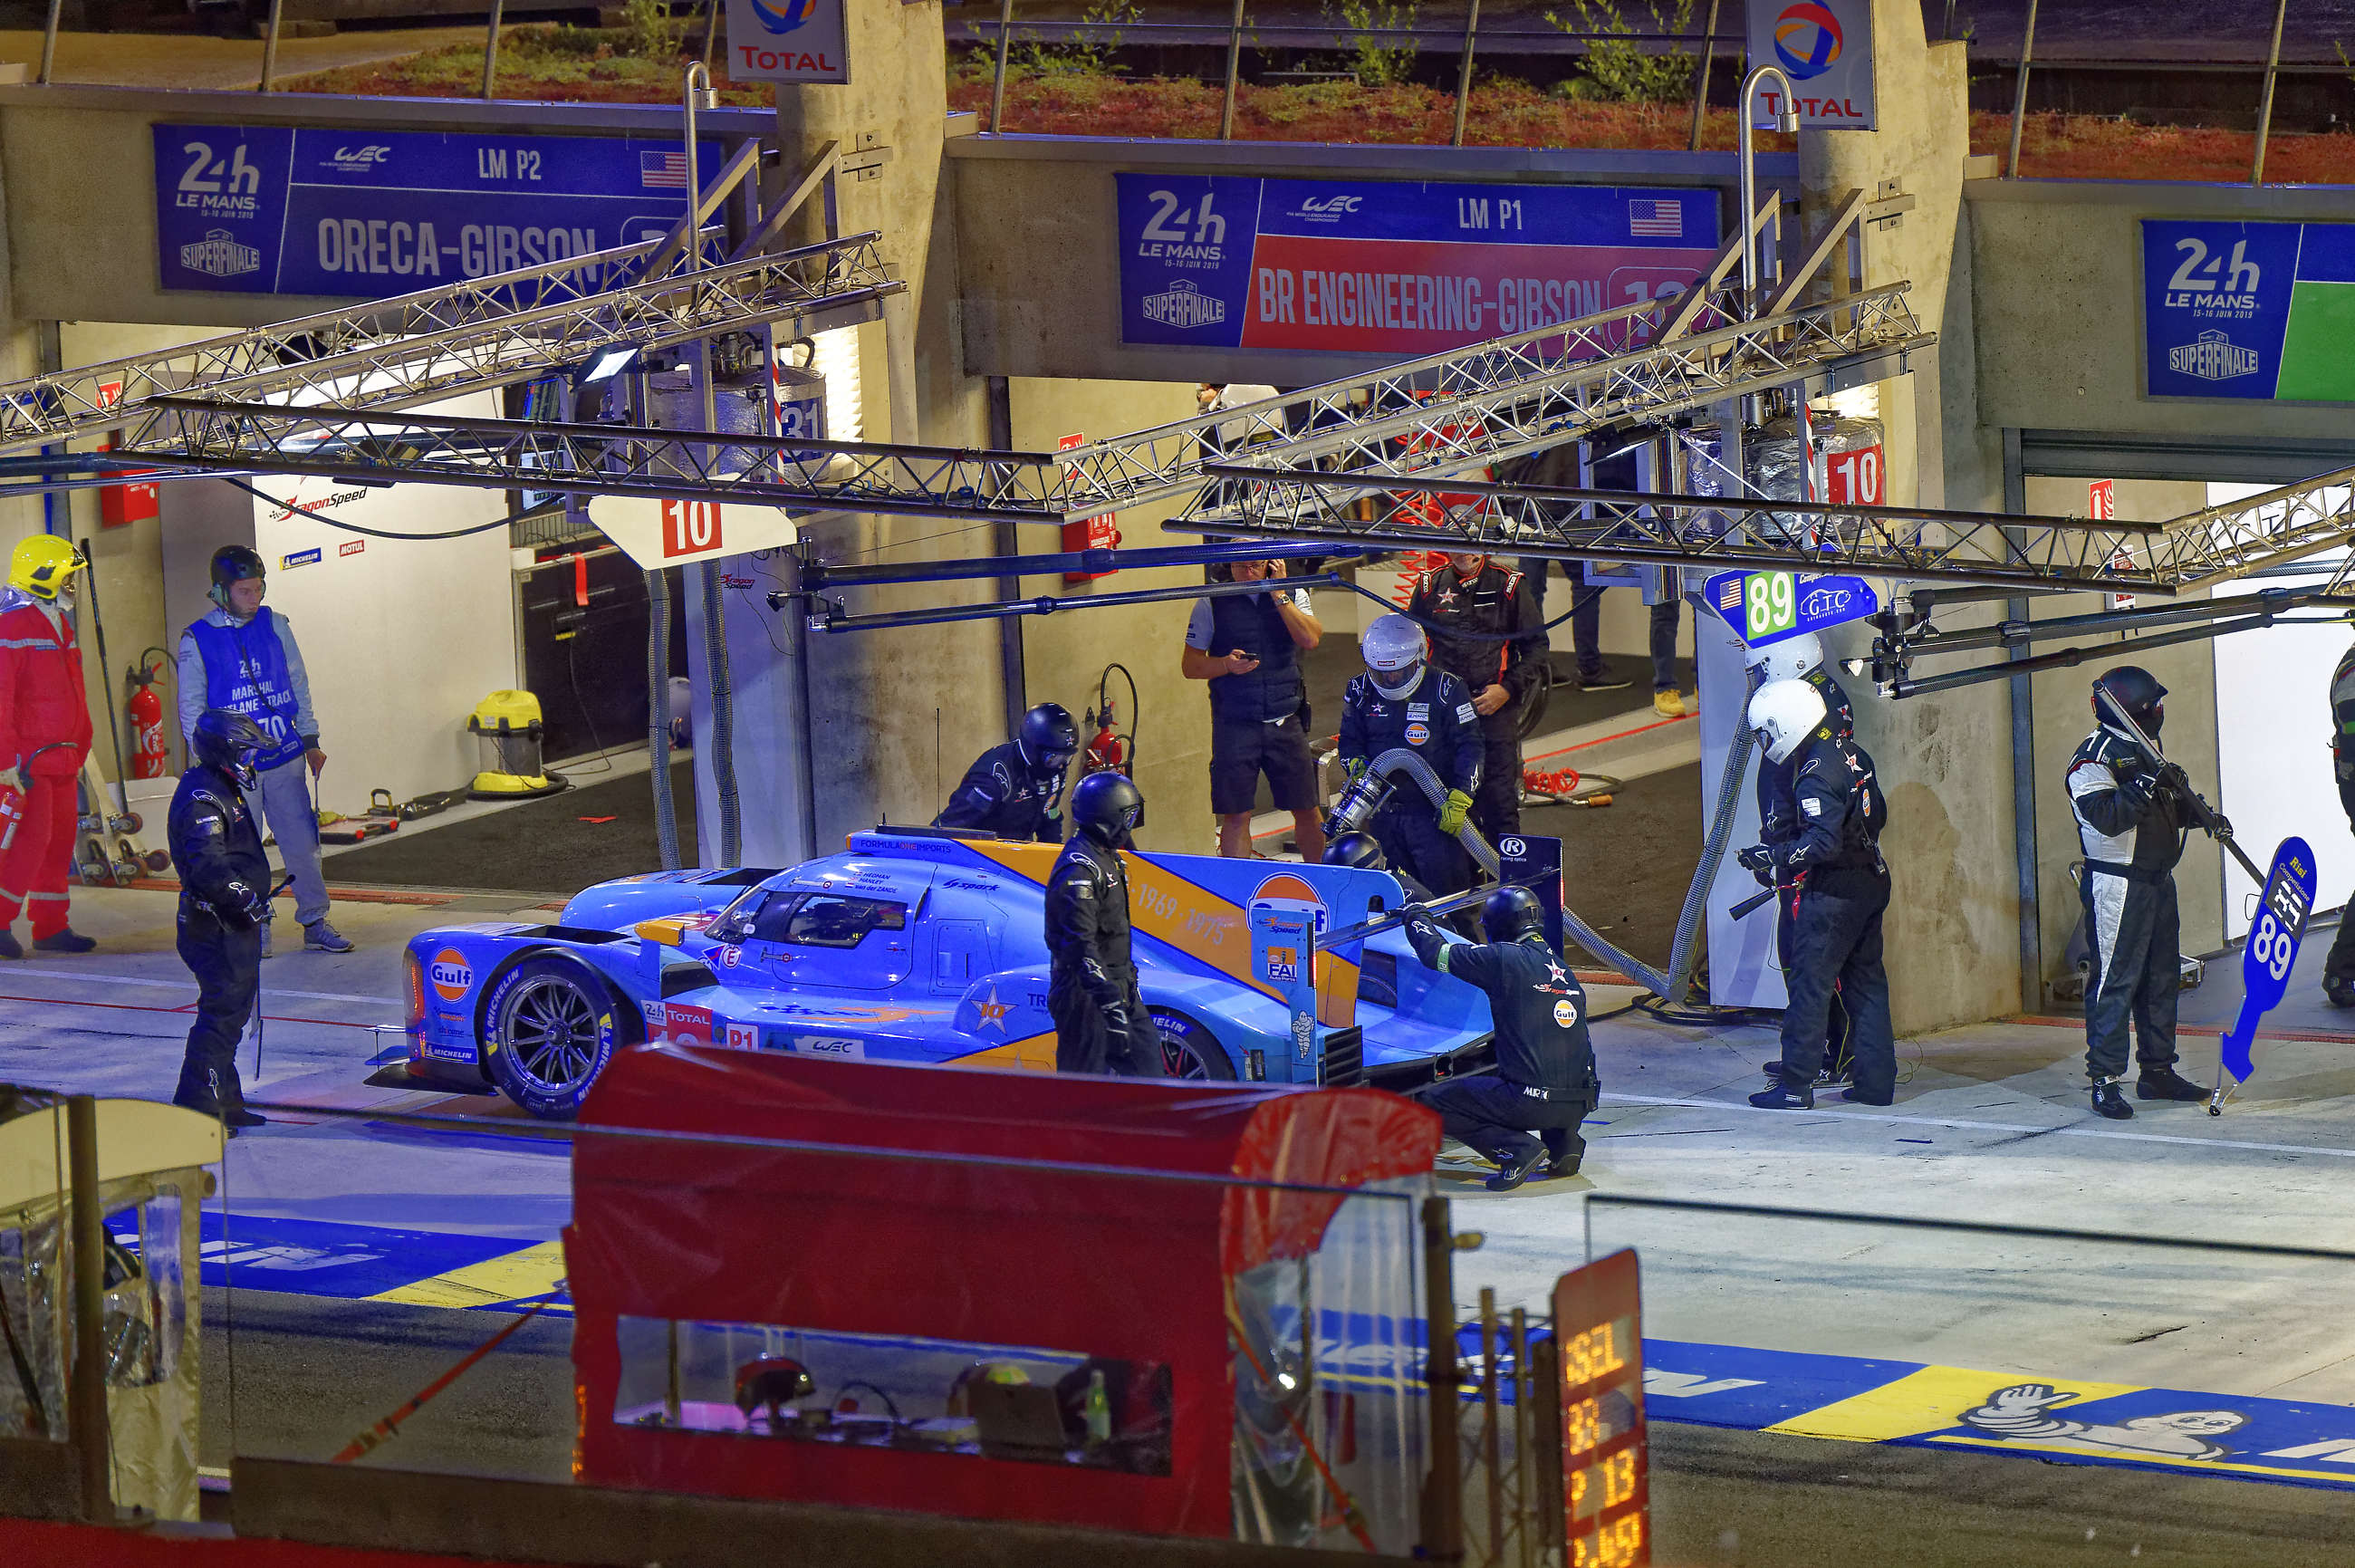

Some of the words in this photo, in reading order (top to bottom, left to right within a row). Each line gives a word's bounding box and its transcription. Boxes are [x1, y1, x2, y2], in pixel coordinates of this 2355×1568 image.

[738, 45, 837, 72] TOTAL
[334, 146, 391, 162] WEC
[478, 148, 507, 179] LM
[516, 149, 542, 180] P2
[176, 193, 199, 207] LE
[201, 195, 255, 210] MANS
[1302, 195, 1363, 213] WEC
[1458, 197, 1489, 229] LM
[1500, 198, 1524, 230] P1
[1141, 189, 1226, 244] 24h
[182, 240, 259, 274] SUPERFINALE
[318, 217, 598, 284] ORECA-GIBSON
[1139, 243, 1164, 256] LE
[1166, 245, 1222, 260] MANS
[2168, 237, 2261, 293] 24h
[1144, 291, 1224, 327] SUPERFINALE
[1258, 267, 1296, 324] BR
[1302, 270, 1600, 335] ENGINEERING-GIBSON
[2165, 293, 2191, 307] LE
[2195, 293, 2254, 309] MANS
[2194, 309, 2213, 318] 15-16
[2216, 310, 2232, 318] JUIN
[2235, 311, 2253, 319] 2019
[2171, 341, 2256, 379] SUPERFINALE
[781, 403, 819, 457] 31
[1837, 452, 1877, 505] 10
[668, 500, 712, 550] 10
[291, 553, 318, 564] MICHELIN
[340, 542, 363, 555] MOTUL
[1749, 572, 1793, 633] 89
[1809, 592, 1846, 616] GTC
[257, 715, 287, 744] 70
[1407, 730, 1427, 738] Gulf
[2289, 856, 2308, 879] Risi
[2279, 862, 2311, 902] Competizione
[1138, 883, 1178, 919] 1969
[1186, 908, 1226, 945] 1975
[2254, 914, 2292, 981] 89
[431, 965, 471, 985] Gulf
[1269, 963, 1296, 976] FAI
[486, 968, 520, 1029] MICHELIN
[981, 1003, 1005, 1018] 10
[667, 1009, 711, 1025] TOTAL
[1556, 1009, 1574, 1018] Gulf
[434, 1048, 473, 1059] MICHELIN
[729, 1029, 753, 1051] P1
[812, 1040, 853, 1053] WEC
